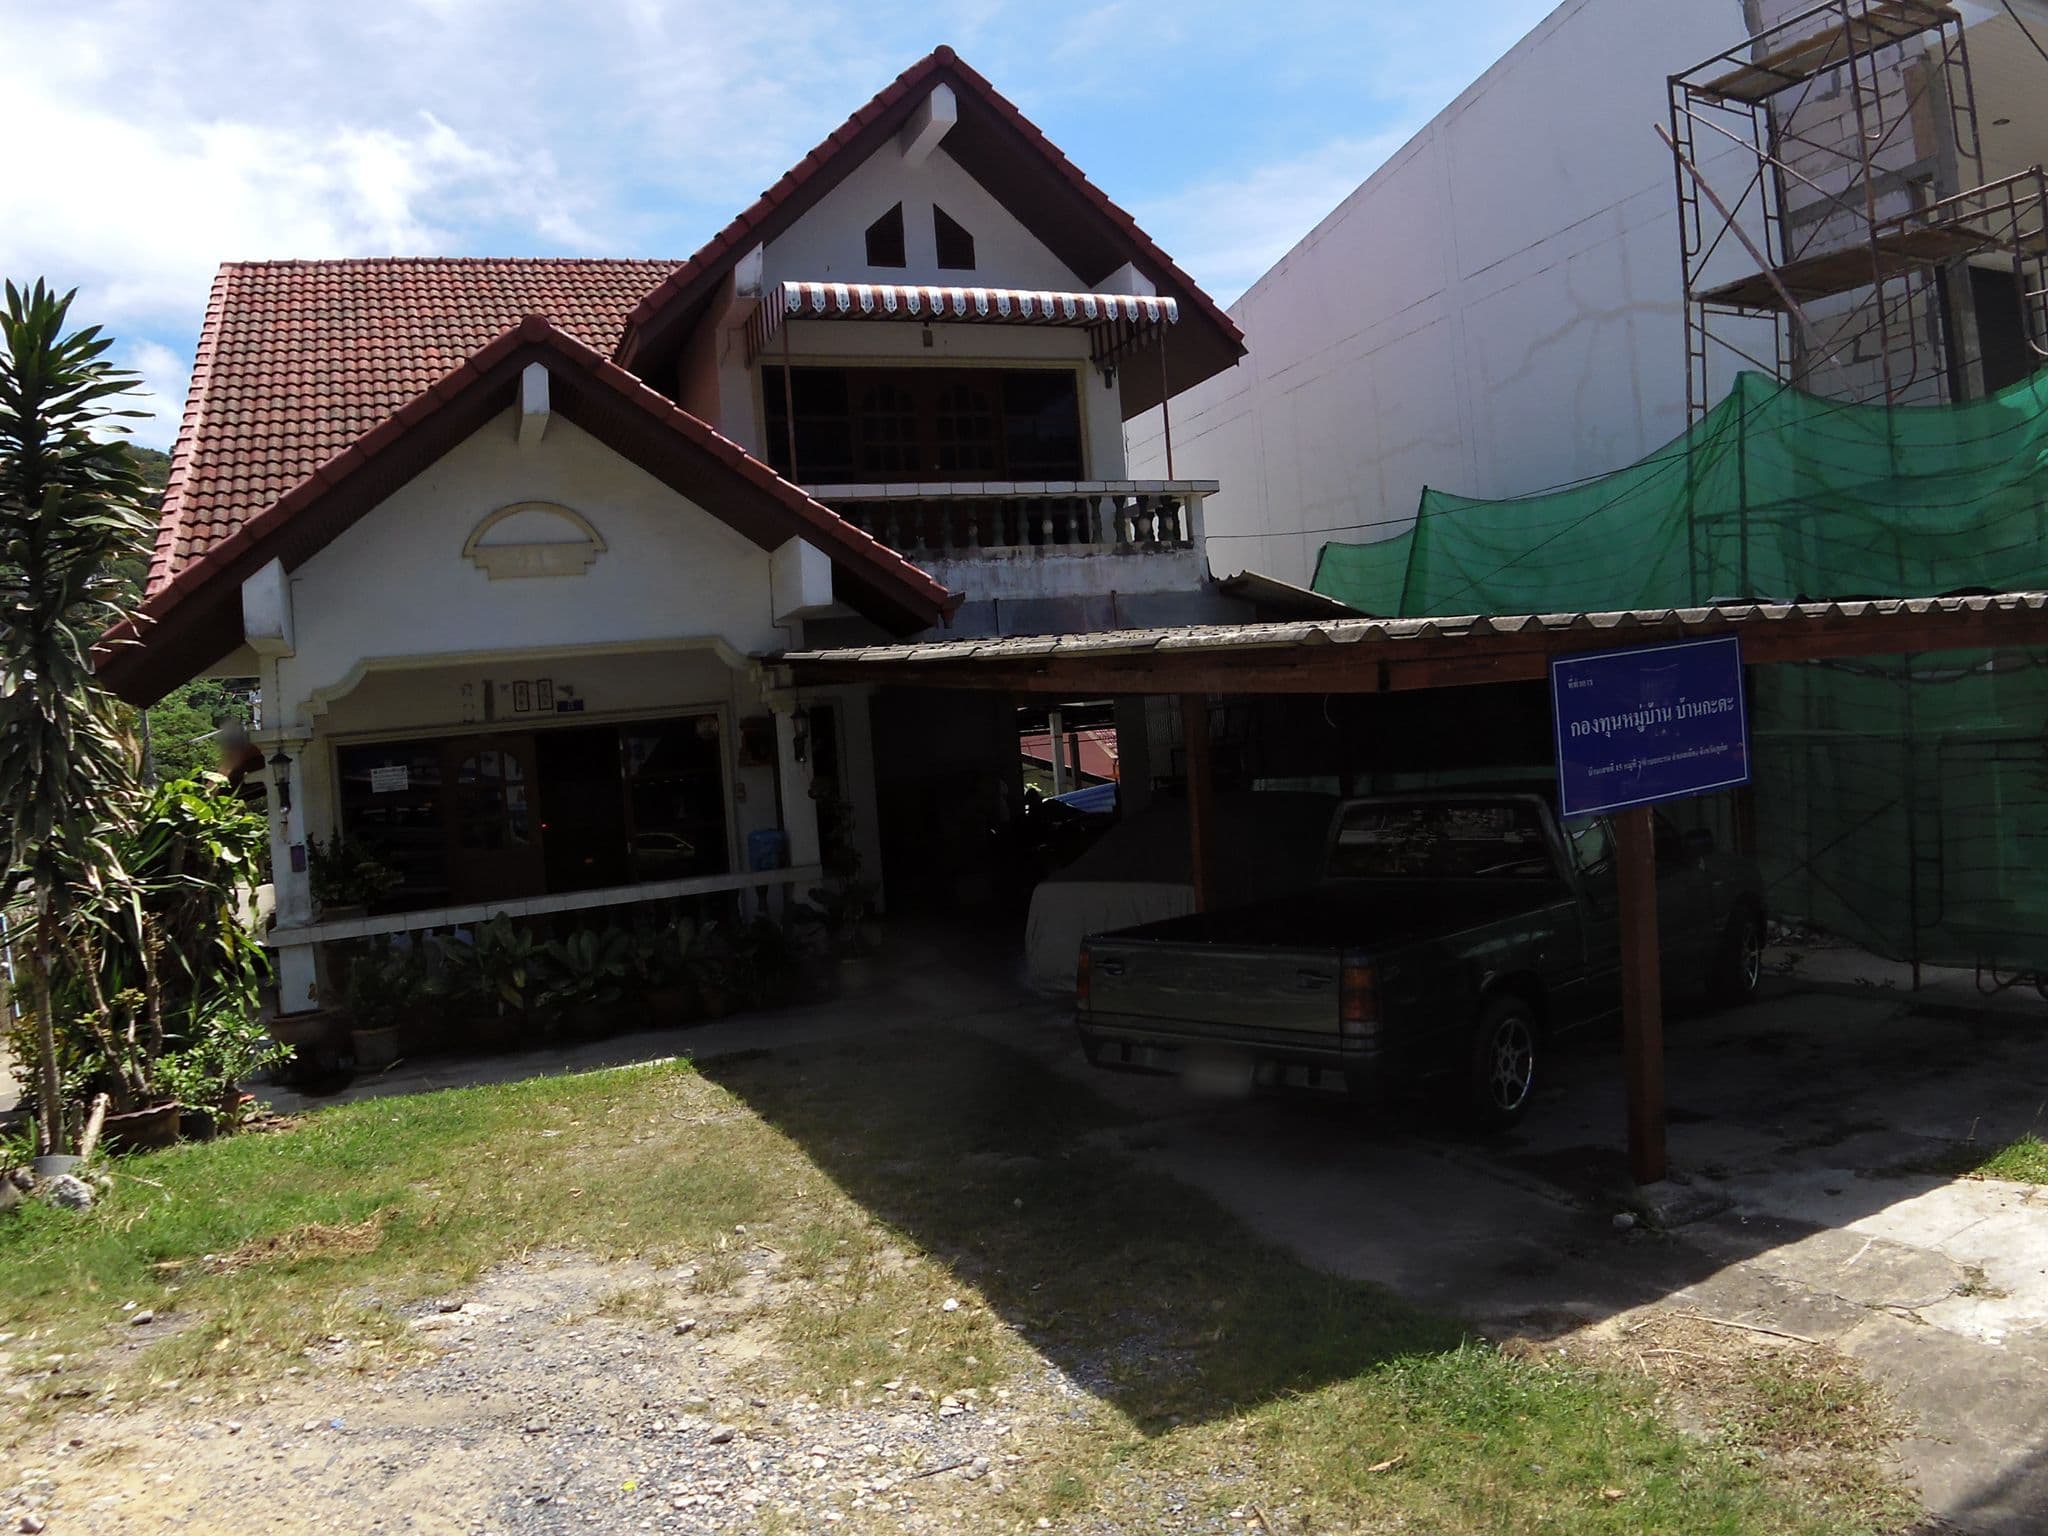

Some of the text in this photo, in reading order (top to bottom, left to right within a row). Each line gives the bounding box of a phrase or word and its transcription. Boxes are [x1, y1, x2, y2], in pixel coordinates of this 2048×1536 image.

[1570, 701, 1672, 738] กองทุนหมู่บ้าน
